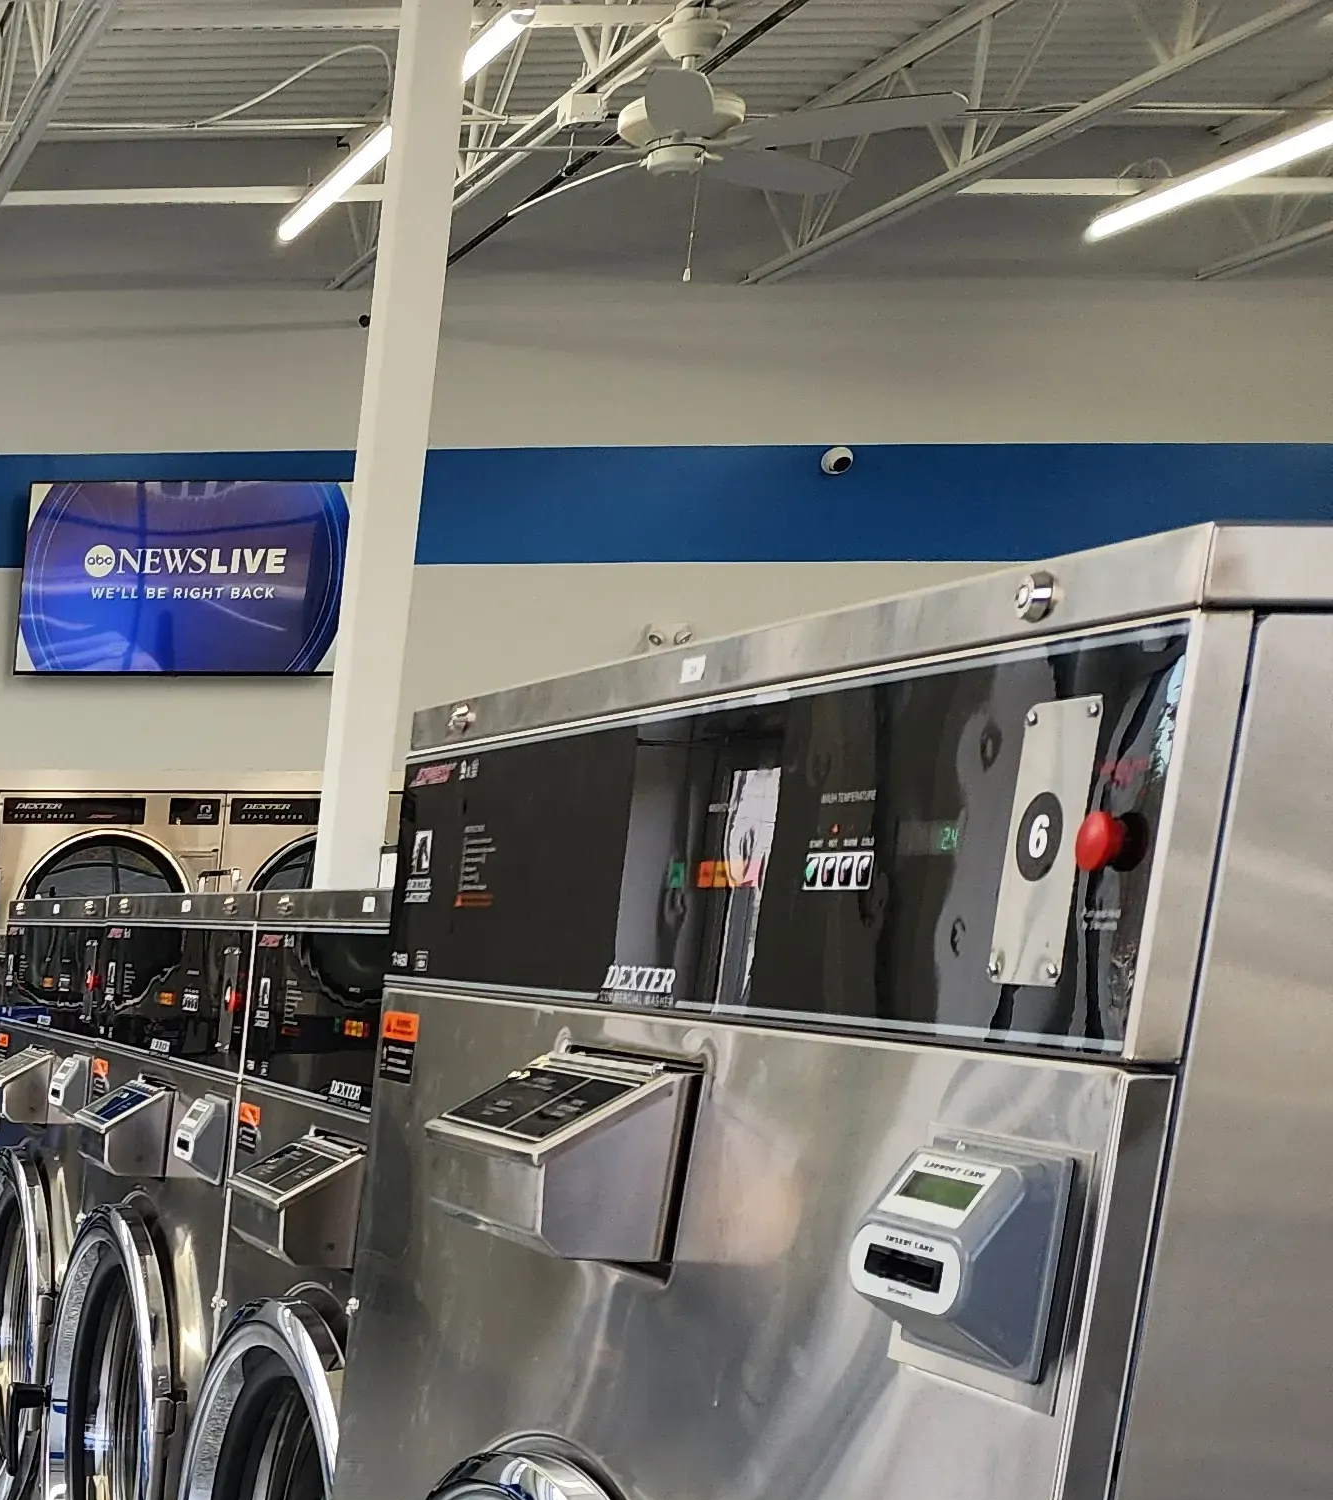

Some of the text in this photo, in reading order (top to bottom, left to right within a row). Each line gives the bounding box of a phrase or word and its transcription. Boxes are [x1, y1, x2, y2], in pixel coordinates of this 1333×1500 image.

[86, 553, 114, 567] abc
[91, 586, 275, 600] WE'LL BE RIGHT BACK
[1028, 813, 1051, 859] 6
[600, 965, 676, 993] DEXTER
[330, 1079, 362, 1101] DEXTER
